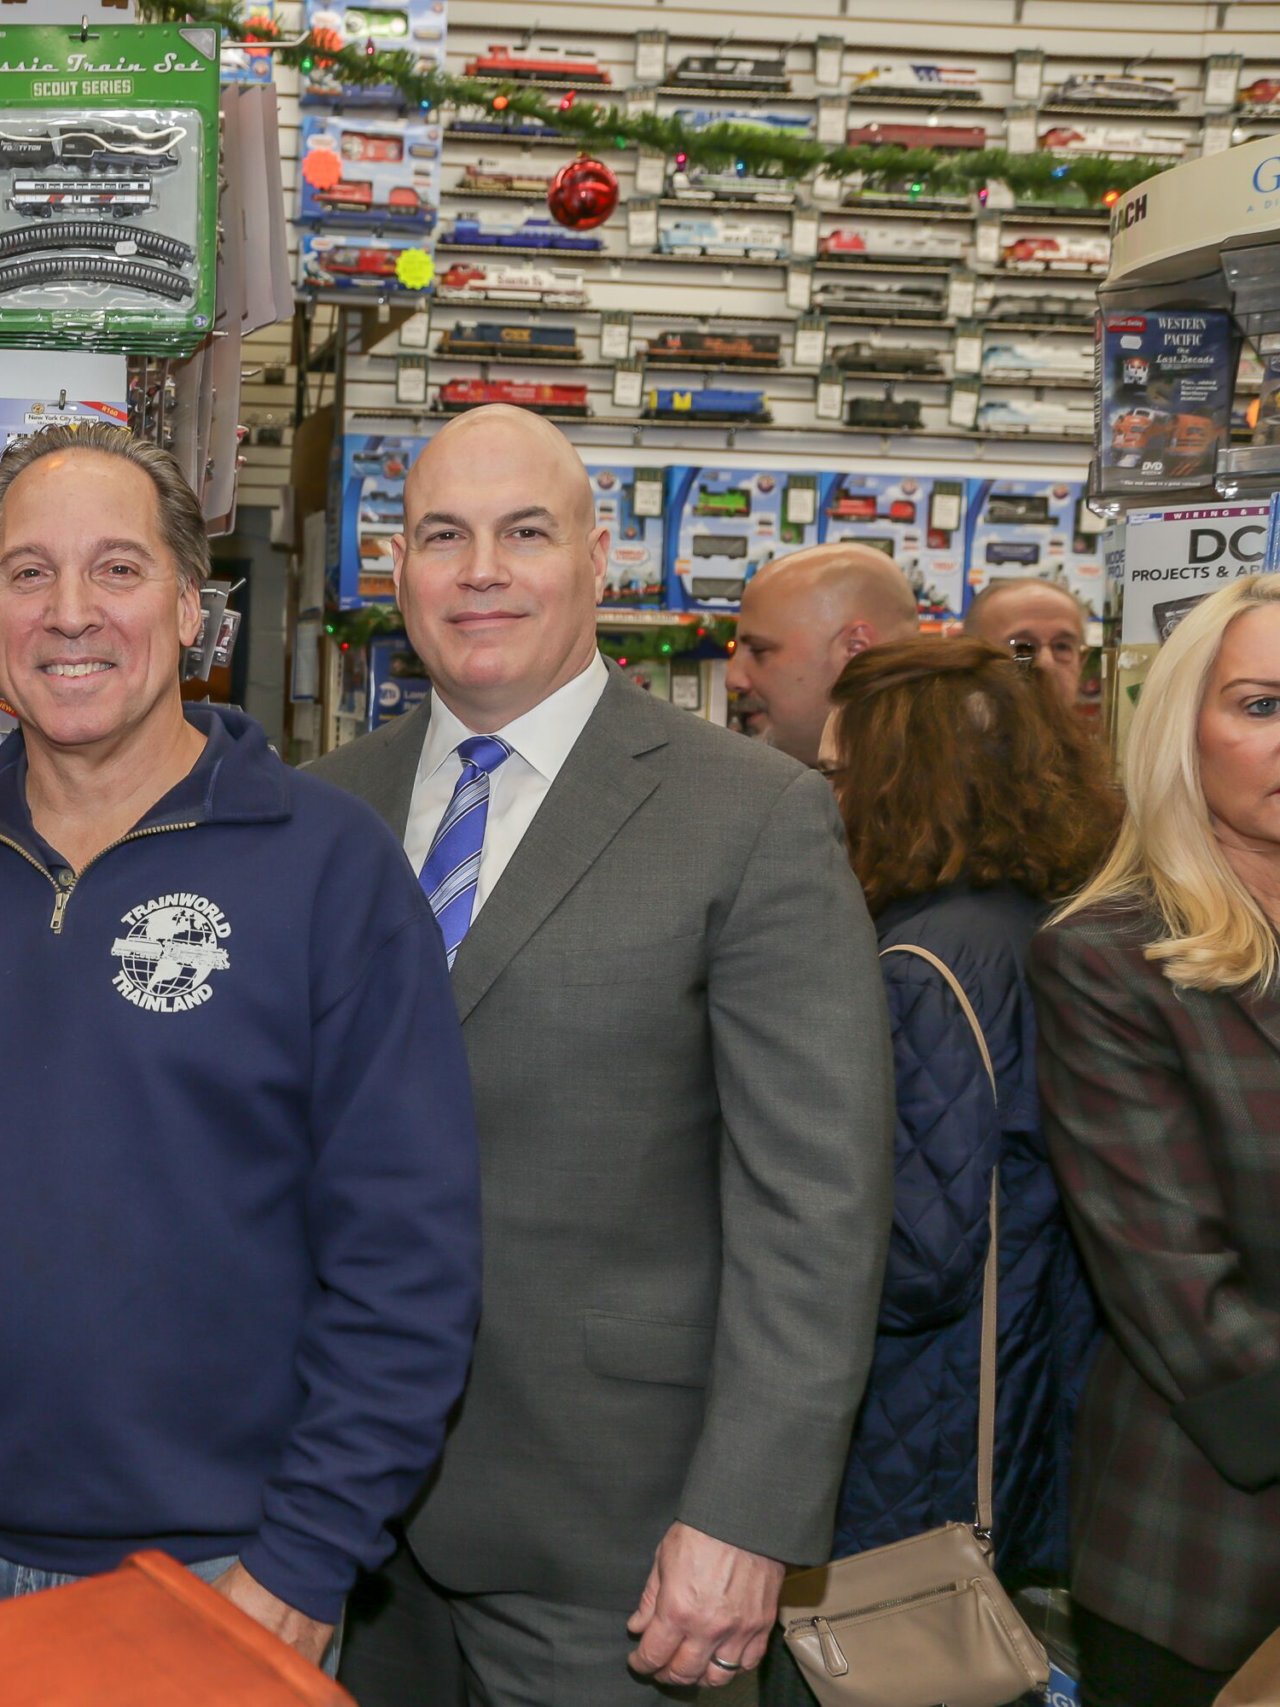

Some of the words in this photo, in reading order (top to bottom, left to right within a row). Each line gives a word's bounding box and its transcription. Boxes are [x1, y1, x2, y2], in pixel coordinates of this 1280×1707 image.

[66, 53, 147, 73] Train
[153, 53, 206, 73] Set
[33, 81, 78, 97] SCOUT
[81, 79, 132, 95] SERIES
[1158, 317, 1207, 331] WESTERN
[1163, 334, 1203, 347] PACIFIC
[1156, 354, 1177, 364] Last
[1180, 354, 1215, 364] Decade
[101, 405, 119, 417] R160
[73, 415, 98, 423] Subway
[1142, 461, 1164, 471] DVD
[1174, 510, 1230, 520] WIRING
[1131, 566, 1210, 582] PROJECTS
[1216, 565, 1229, 578] &
[120, 892, 233, 939] TRAINWORLD
[111, 969, 214, 1013] TRAINLAND
